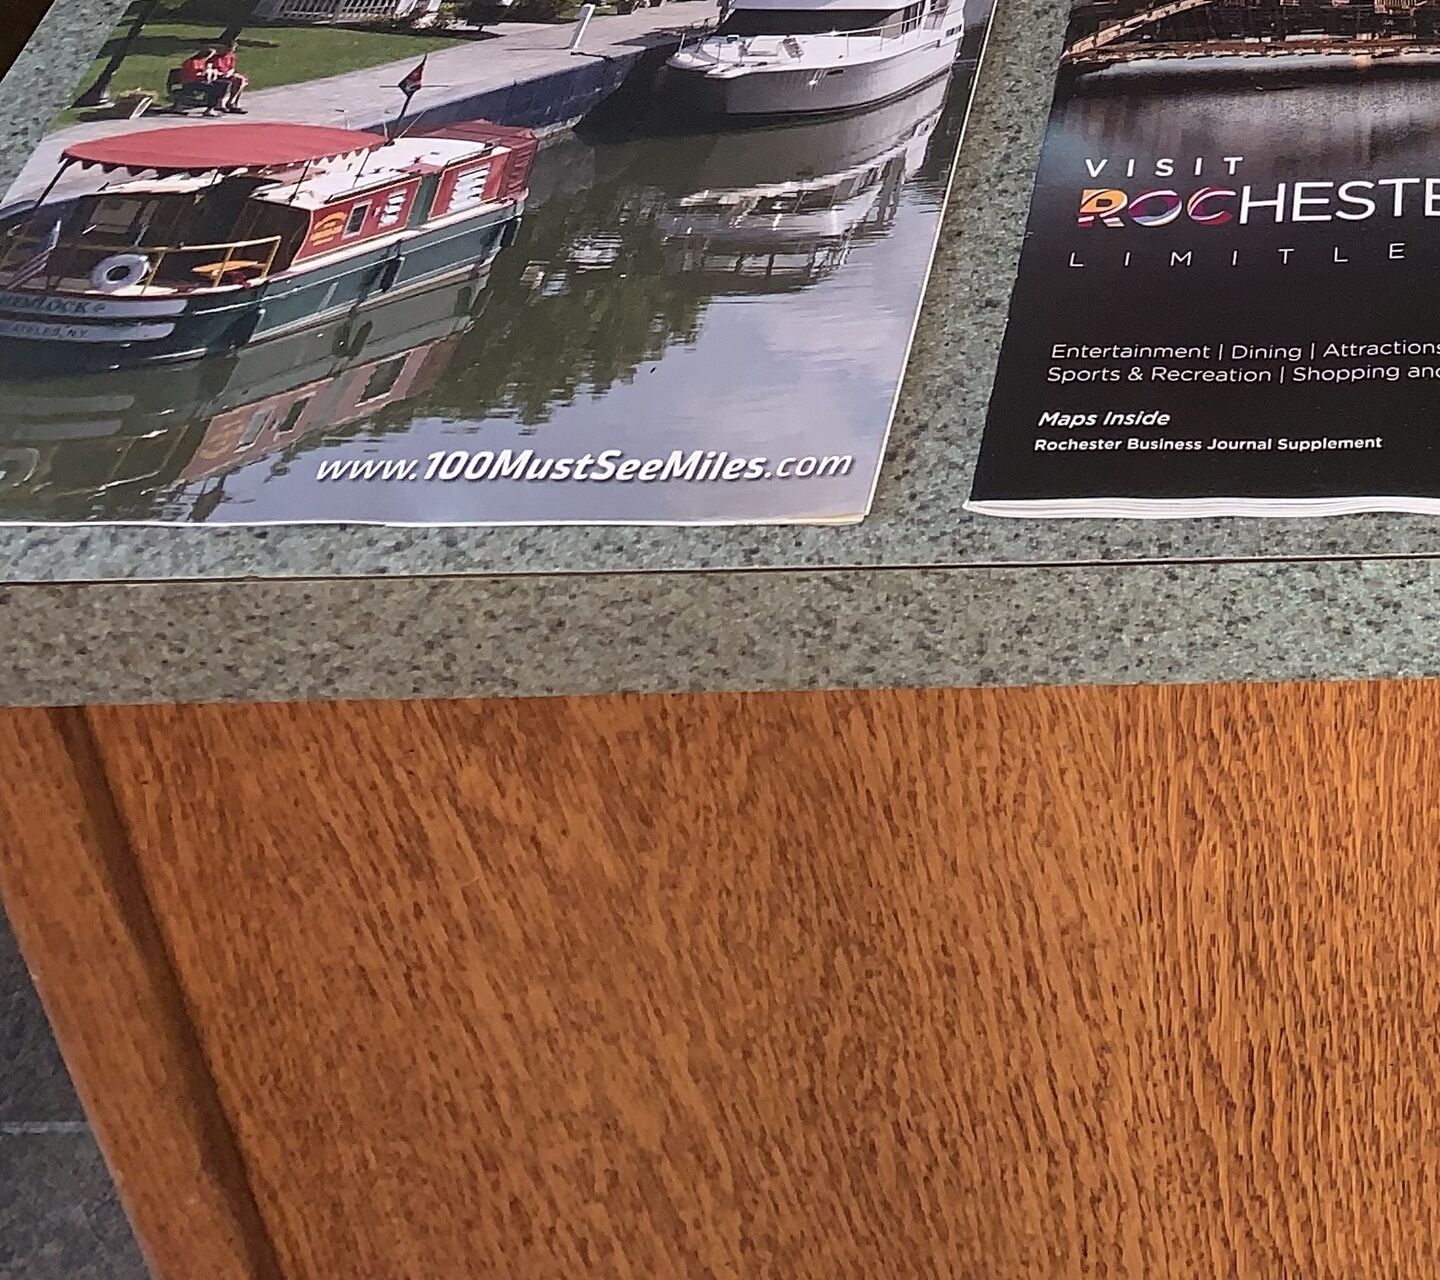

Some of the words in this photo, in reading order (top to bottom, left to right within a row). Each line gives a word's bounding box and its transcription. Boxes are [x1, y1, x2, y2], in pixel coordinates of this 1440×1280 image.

[1084, 156, 1245, 179] VISIT
[1051, 343, 1211, 361] Entertainment
[1232, 344, 1303, 362] Dining
[1047, 366, 1121, 385] Sports
[1127, 366, 1143, 382] &
[1151, 365, 1271, 383] Recreation
[1292, 363, 1400, 385] Shopping
[1037, 410, 1098, 431] Maps
[1102, 408, 1171, 427] Inside
[1034, 438, 1122, 452] Rochester
[1127, 437, 1203, 451] Business
[1207, 438, 1272, 450] Journal
[1277, 436, 1383, 453] Supplement
[316, 447, 853, 484] www.100MustSeeMiles.com
